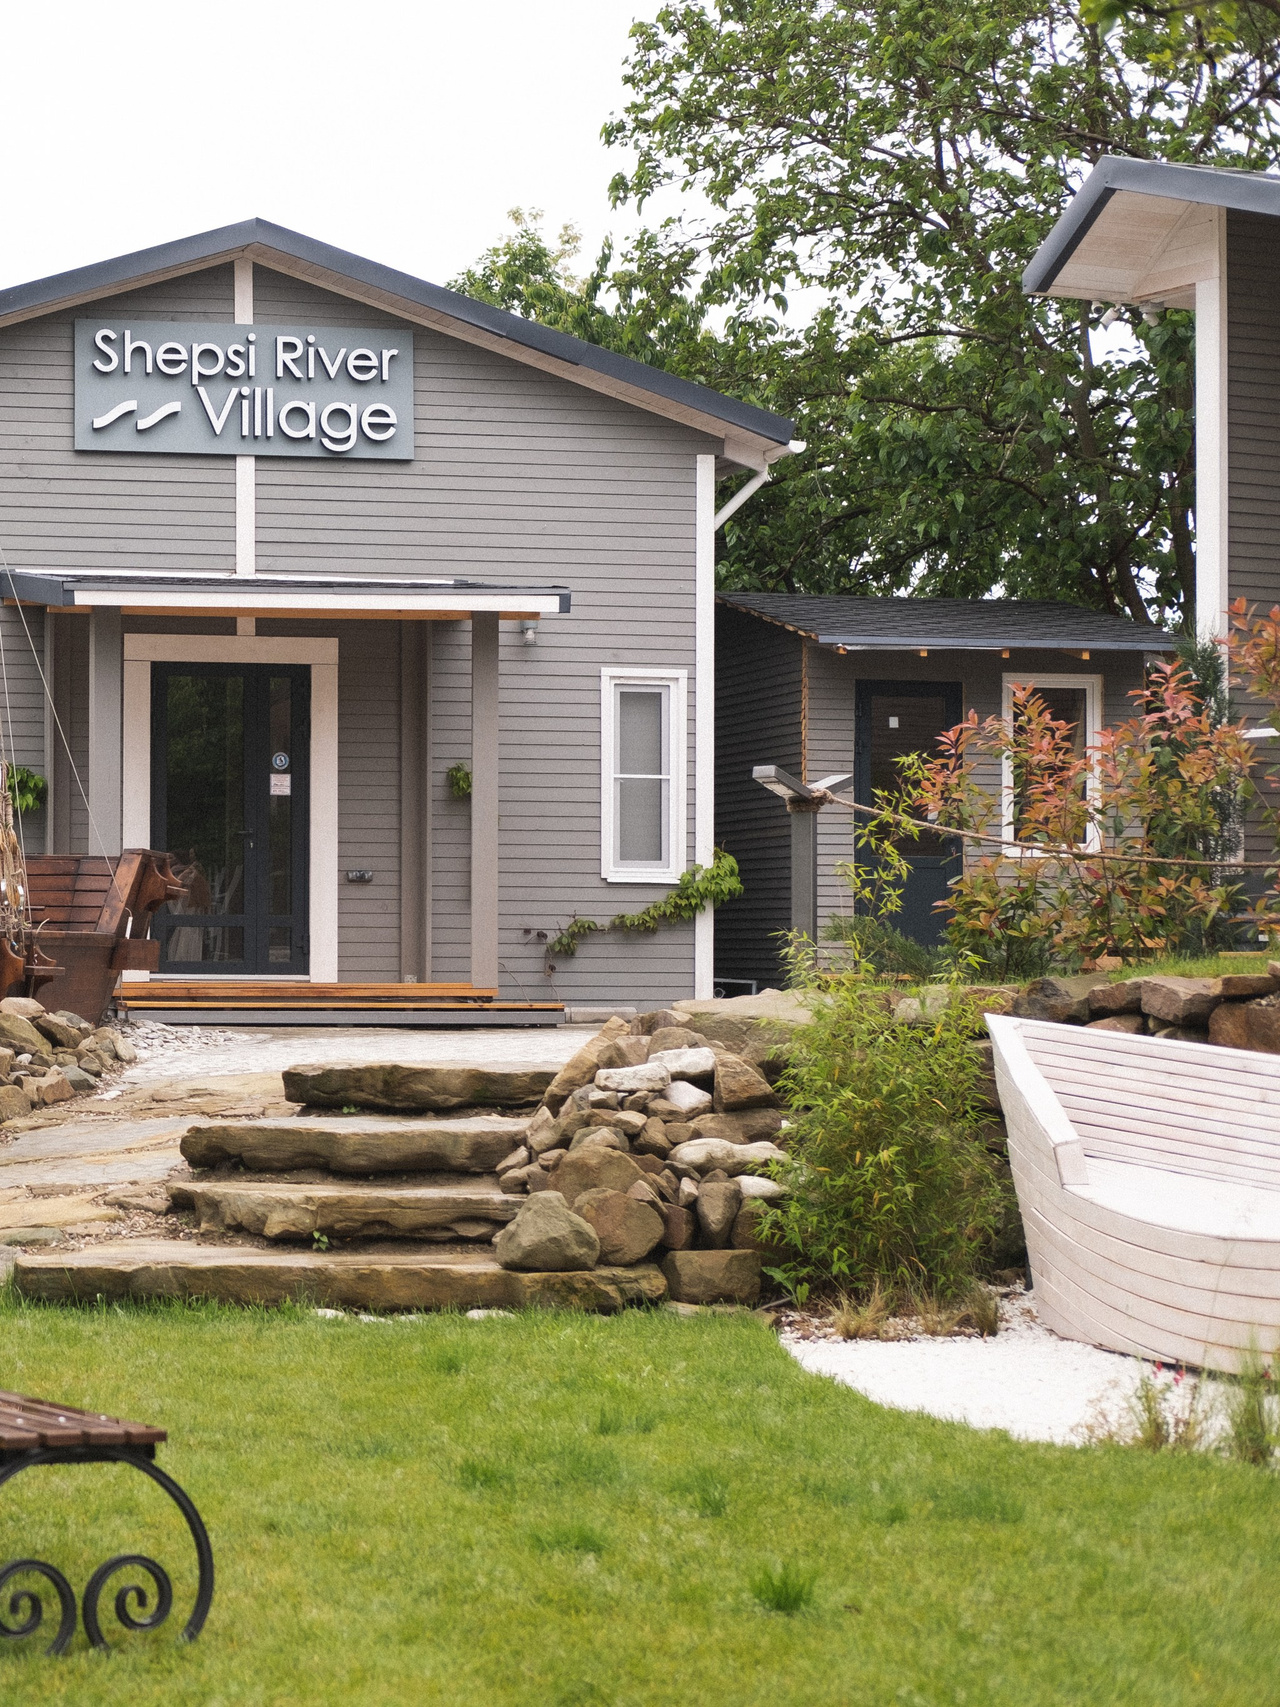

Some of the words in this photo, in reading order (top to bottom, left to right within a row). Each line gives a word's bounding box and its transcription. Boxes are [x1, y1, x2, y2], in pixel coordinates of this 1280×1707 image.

[91, 328, 257, 386] Shepsi
[275, 334, 399, 382] River
[196, 386, 398, 453] Village
